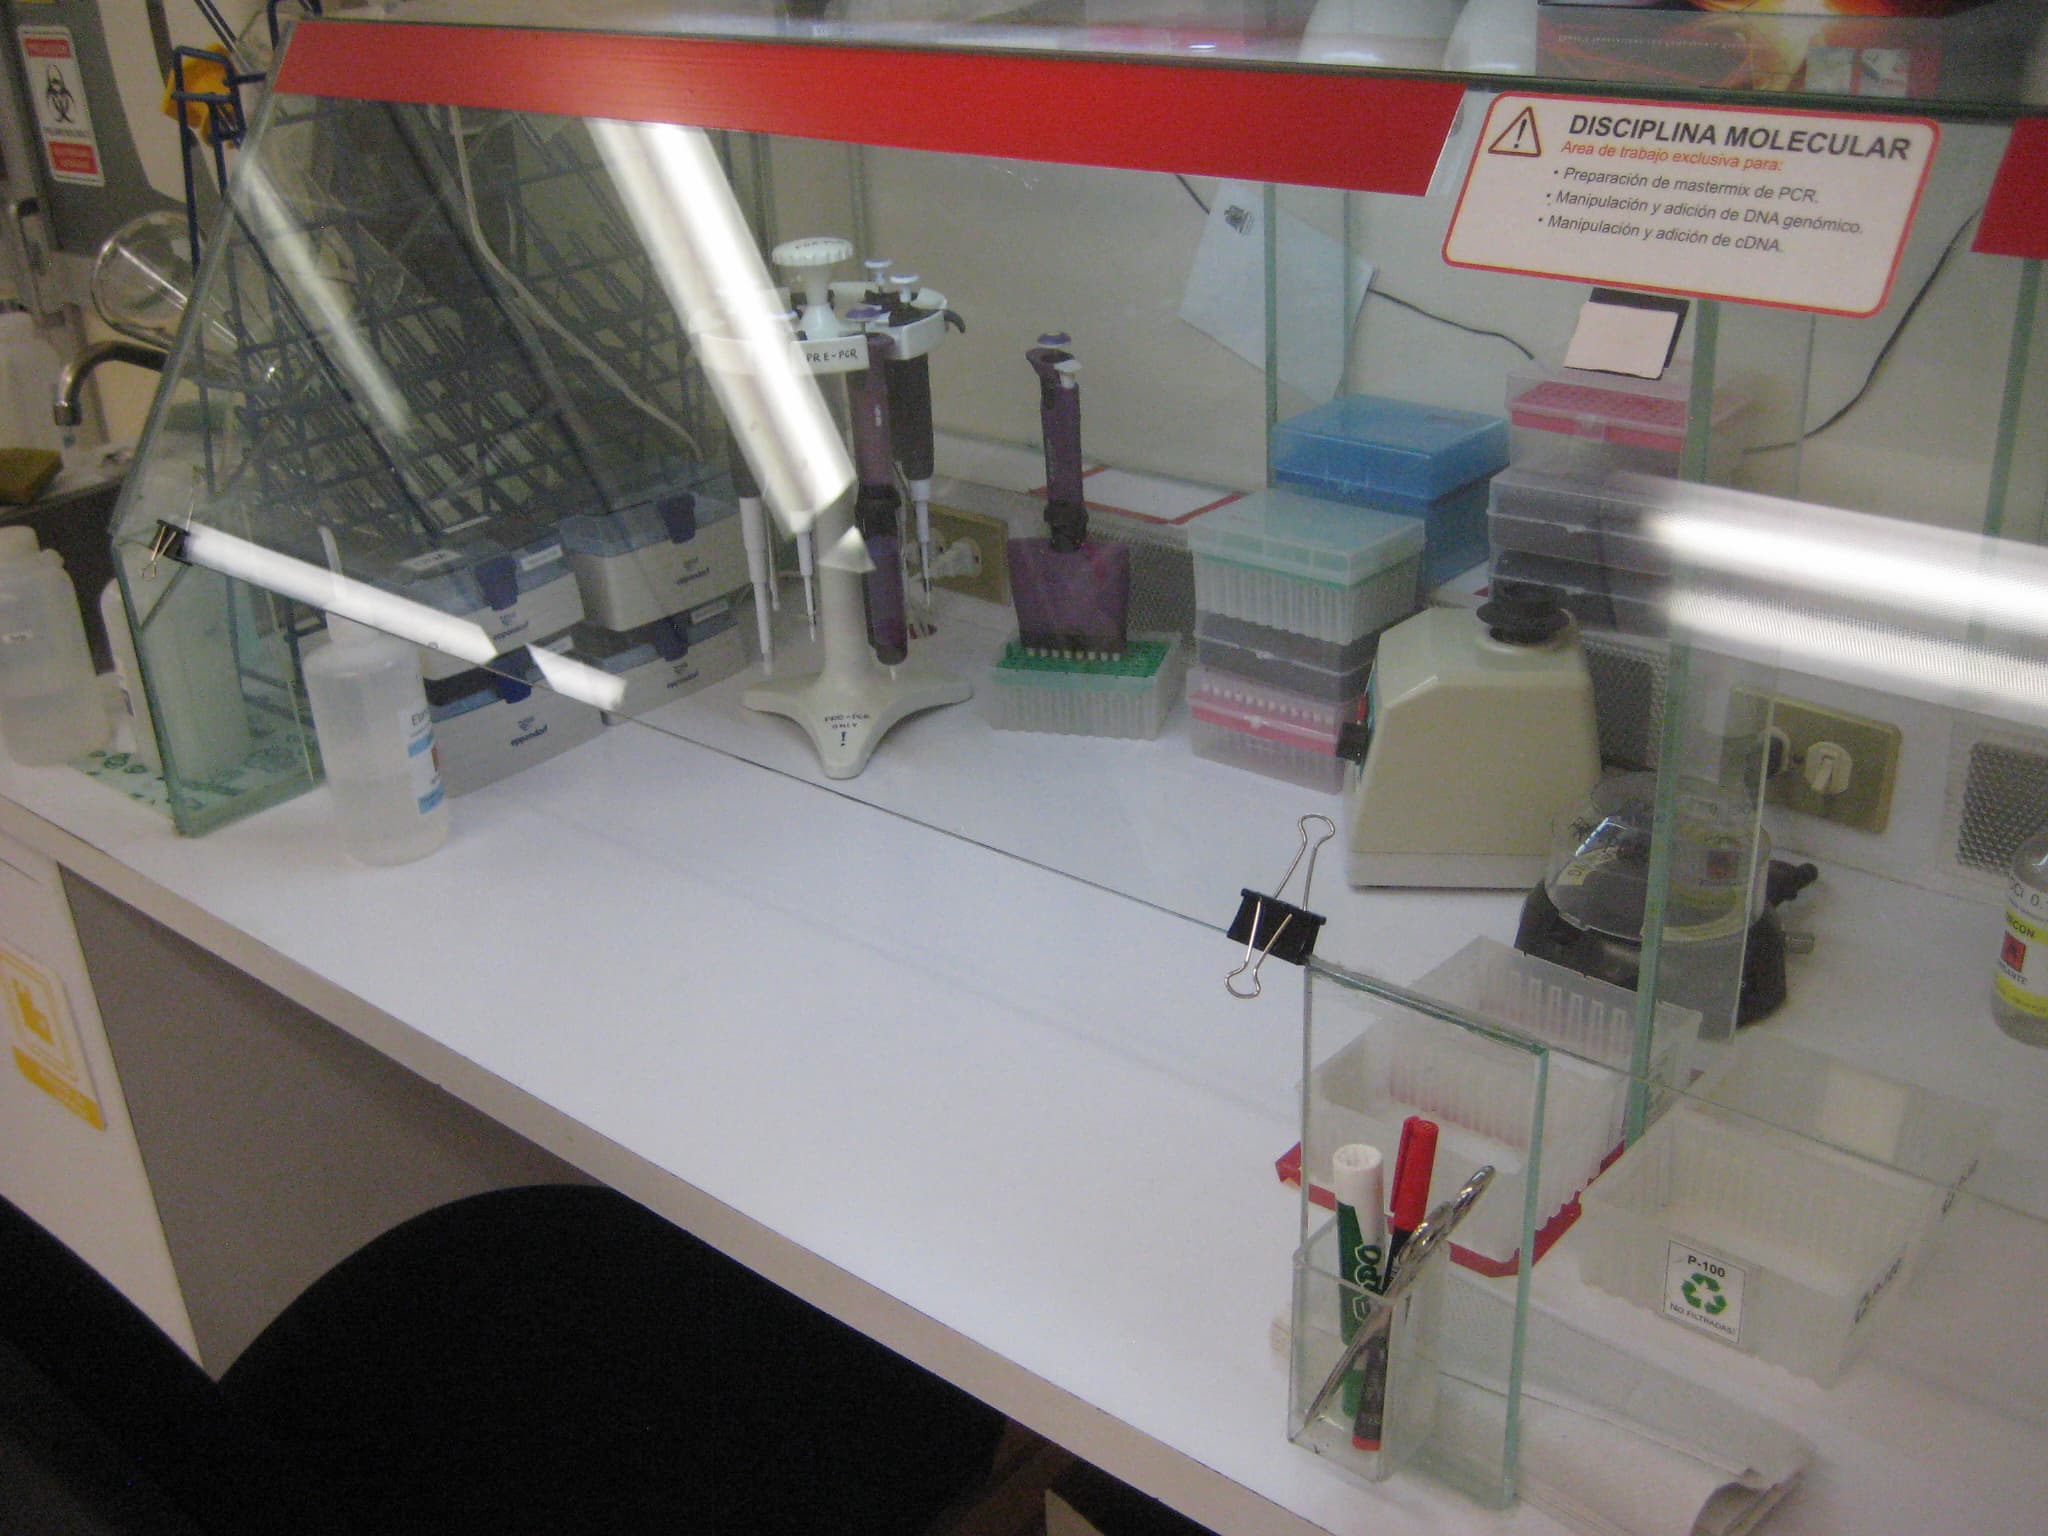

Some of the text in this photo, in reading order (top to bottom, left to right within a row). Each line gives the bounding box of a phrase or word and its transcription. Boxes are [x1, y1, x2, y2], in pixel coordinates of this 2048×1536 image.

[1568, 114, 1911, 160] DISCIPLINA MOLECULAR
[1598, 144, 1617, 157] de
[1620, 146, 1668, 164] trabajo
[1673, 150, 1739, 168] exclusiva
[1742, 158, 1784, 171] para:
[1563, 167, 1818, 203] Preparación de mastermix de PCR.
[1556, 190, 1863, 235] Manipulación y adición de DNA genómico.
[1548, 215, 1784, 252] Manipulación y adición de cDNA.
[806, 347, 858, 363] PRE-PCR
[1687, 1255, 1726, 1278] P-100
[1670, 1302, 1685, 1314] NO
